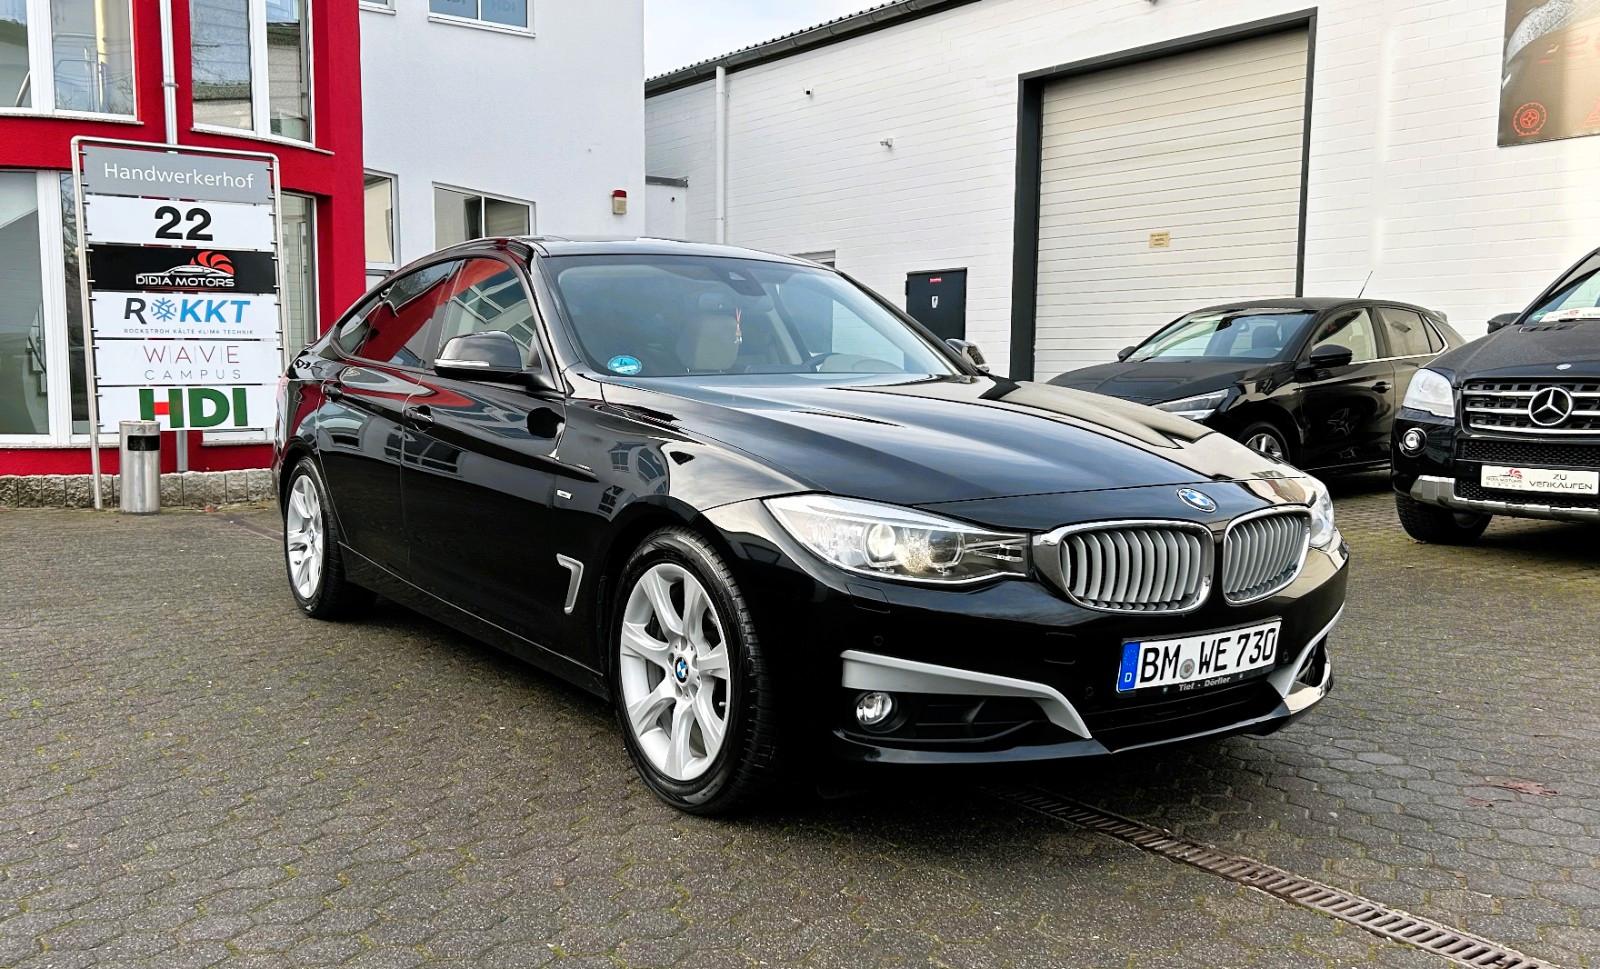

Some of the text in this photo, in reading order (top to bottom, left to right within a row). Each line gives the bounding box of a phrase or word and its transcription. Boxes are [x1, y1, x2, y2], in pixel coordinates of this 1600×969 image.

[104, 162, 254, 189] Handwerkerhof
[154, 205, 214, 242] 22
[136, 274, 235, 288] DIDIA MOTORS
[144, 369, 241, 381] CAMPUS
[138, 387, 249, 429] HDI
[1529, 480, 1593, 490] VERKAUFEN
[1552, 473, 1568, 481] ZU
[1140, 644, 1181, 683] BM
[1198, 637, 1232, 675] WE
[1236, 627, 1277, 668] 730
